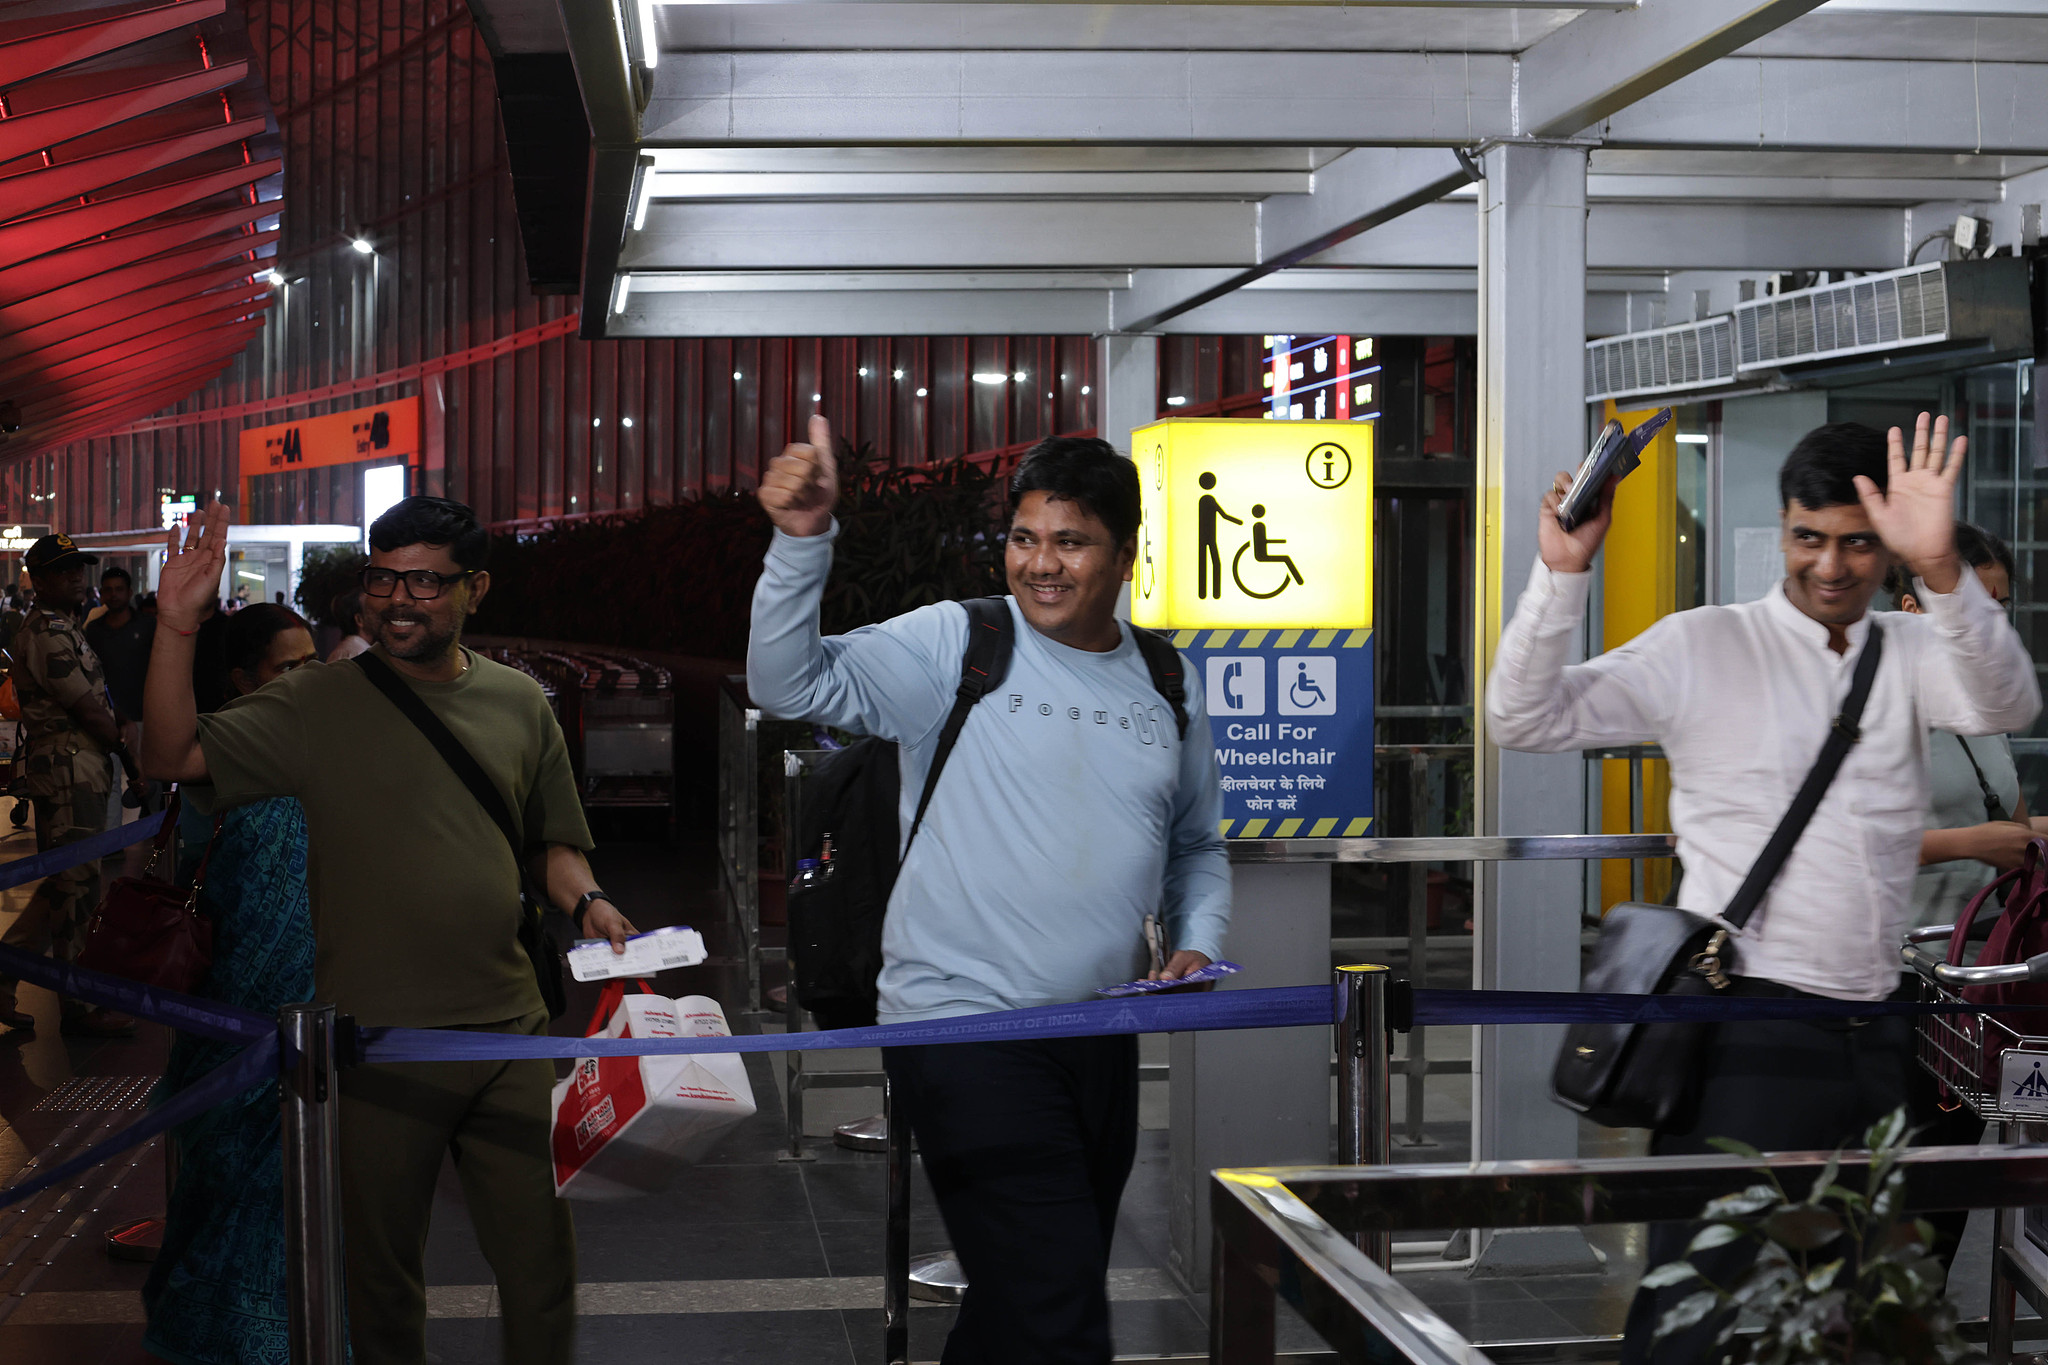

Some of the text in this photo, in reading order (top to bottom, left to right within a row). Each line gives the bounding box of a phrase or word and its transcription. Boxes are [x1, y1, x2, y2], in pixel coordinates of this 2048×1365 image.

[1226, 723, 1317, 741] Call For
[1214, 748, 1336, 766] Wheelchair
[1219, 774, 1326, 791] व्हीलचेयर के लिये
[1246, 794, 1298, 811] फोन करें
[861, 1012, 1088, 1041] AIRPORTS AUTHORITY OF INDIA
